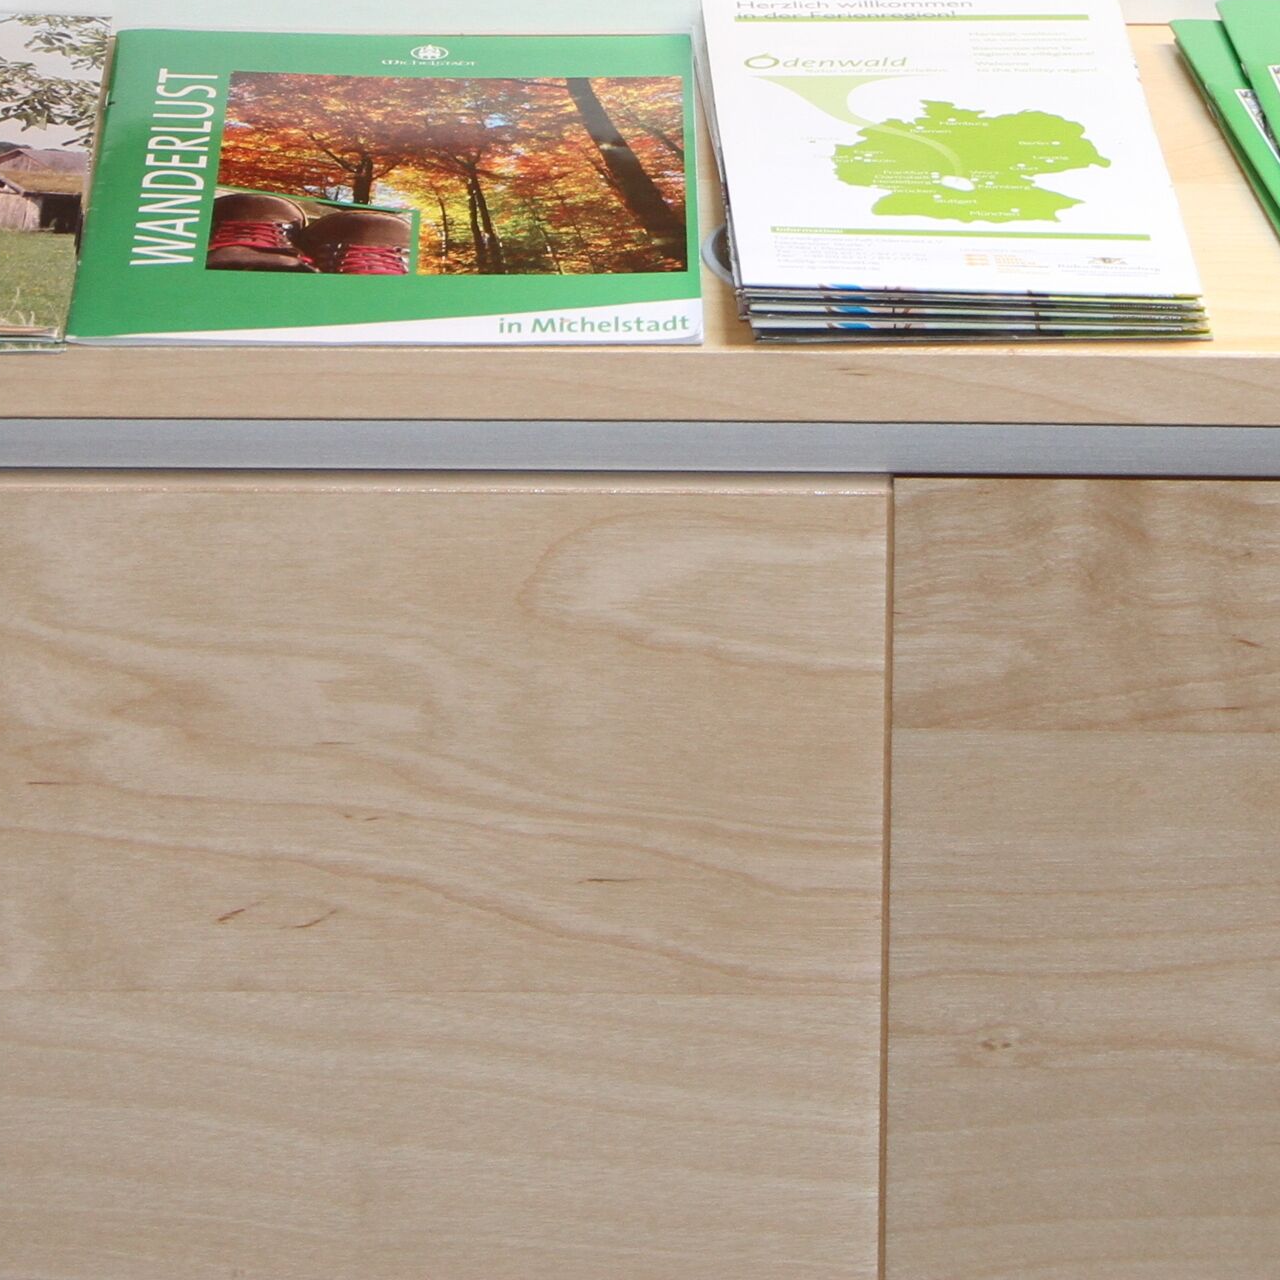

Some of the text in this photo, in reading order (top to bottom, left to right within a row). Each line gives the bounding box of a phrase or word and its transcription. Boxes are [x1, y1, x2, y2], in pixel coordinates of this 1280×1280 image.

[736, 0, 973, 10] Herzlich willkommen
[737, 10, 956, 21] in der Ferienregion!
[743, 52, 908, 70] Odenwald
[130, 68, 218, 266] WANDERLUST
[498, 315, 691, 336] in Michelstadt
